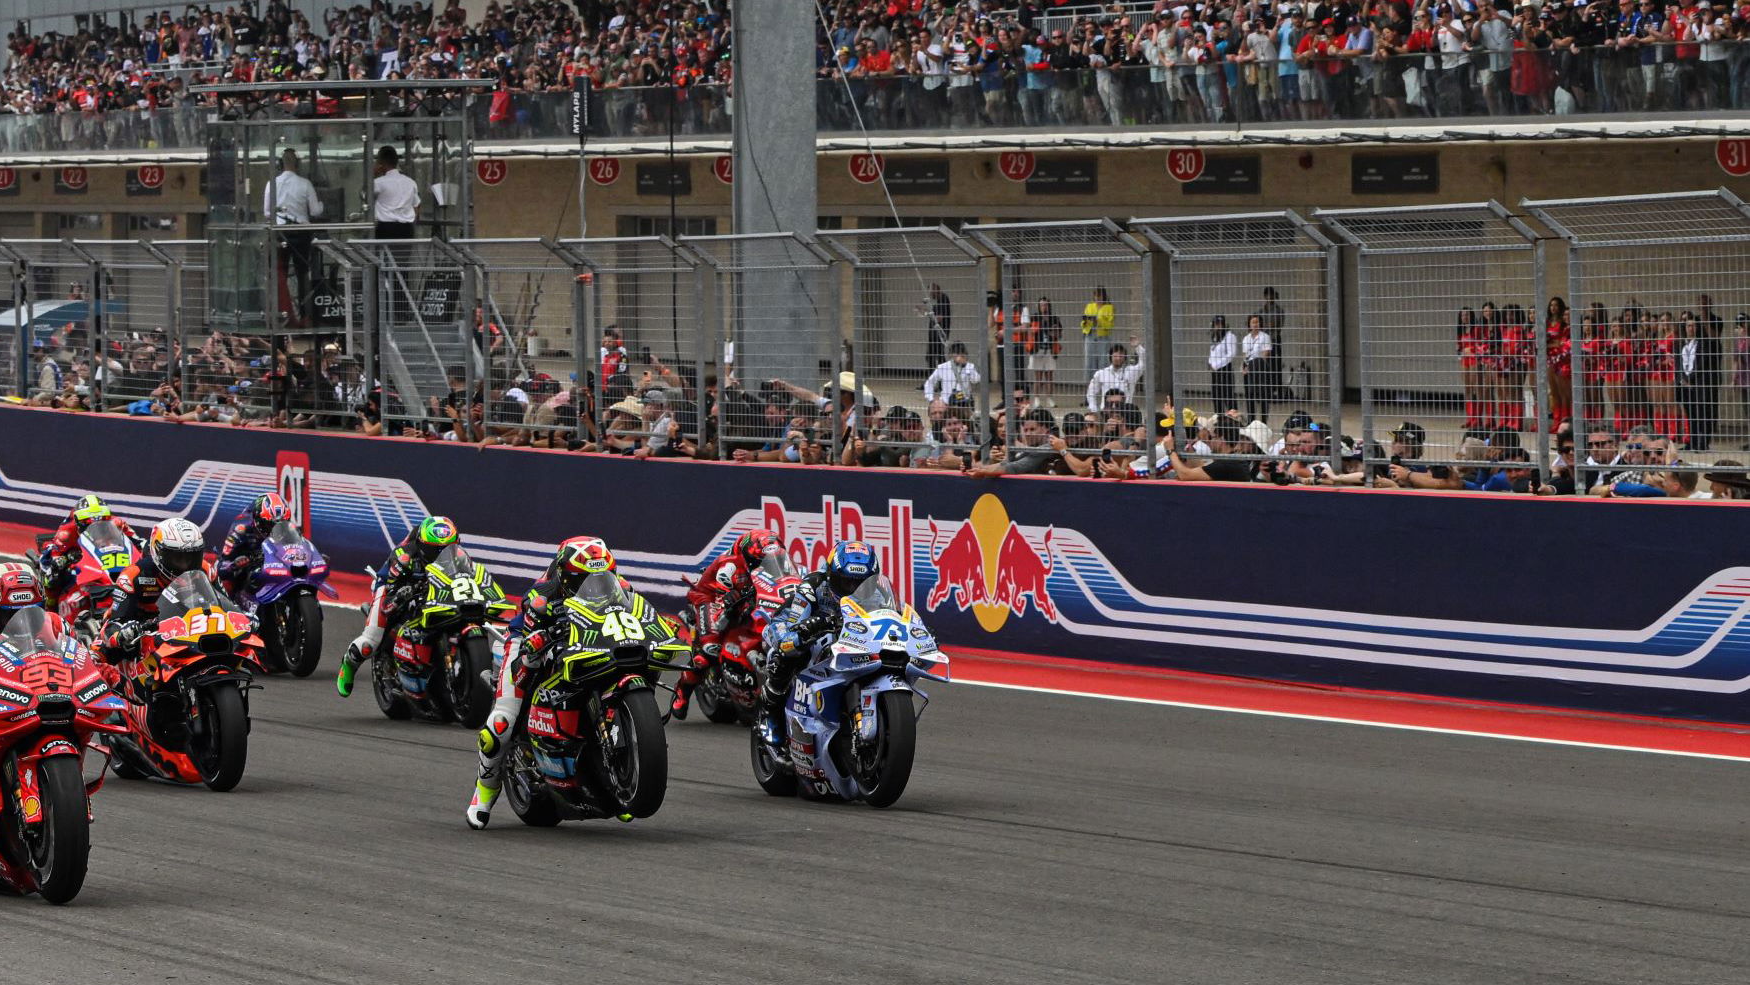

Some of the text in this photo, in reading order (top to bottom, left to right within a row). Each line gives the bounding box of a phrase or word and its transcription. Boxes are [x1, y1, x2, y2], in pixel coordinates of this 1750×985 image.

[1008, 154, 1025, 174] 29
[1176, 153, 1195, 174] 30
[1728, 144, 1747, 166] 31
[144, 168, 158, 183] 23
[484, 164, 500, 180] 25
[597, 161, 613, 178] 26
[722, 160, 732, 177] 2
[858, 158, 876, 176] 28
[68, 170, 81, 184] 22
[322, 305, 363, 317] SART
[101, 553, 130, 570] 36
[450, 577, 484, 602] 21
[604, 605, 625, 614] ebay
[759, 599, 781, 609] Lenov
[189, 612, 226, 635] 37
[602, 611, 646, 642] 49
[870, 618, 909, 642] 73
[20, 663, 74, 687] 93
[79, 683, 108, 703] Lenovo
